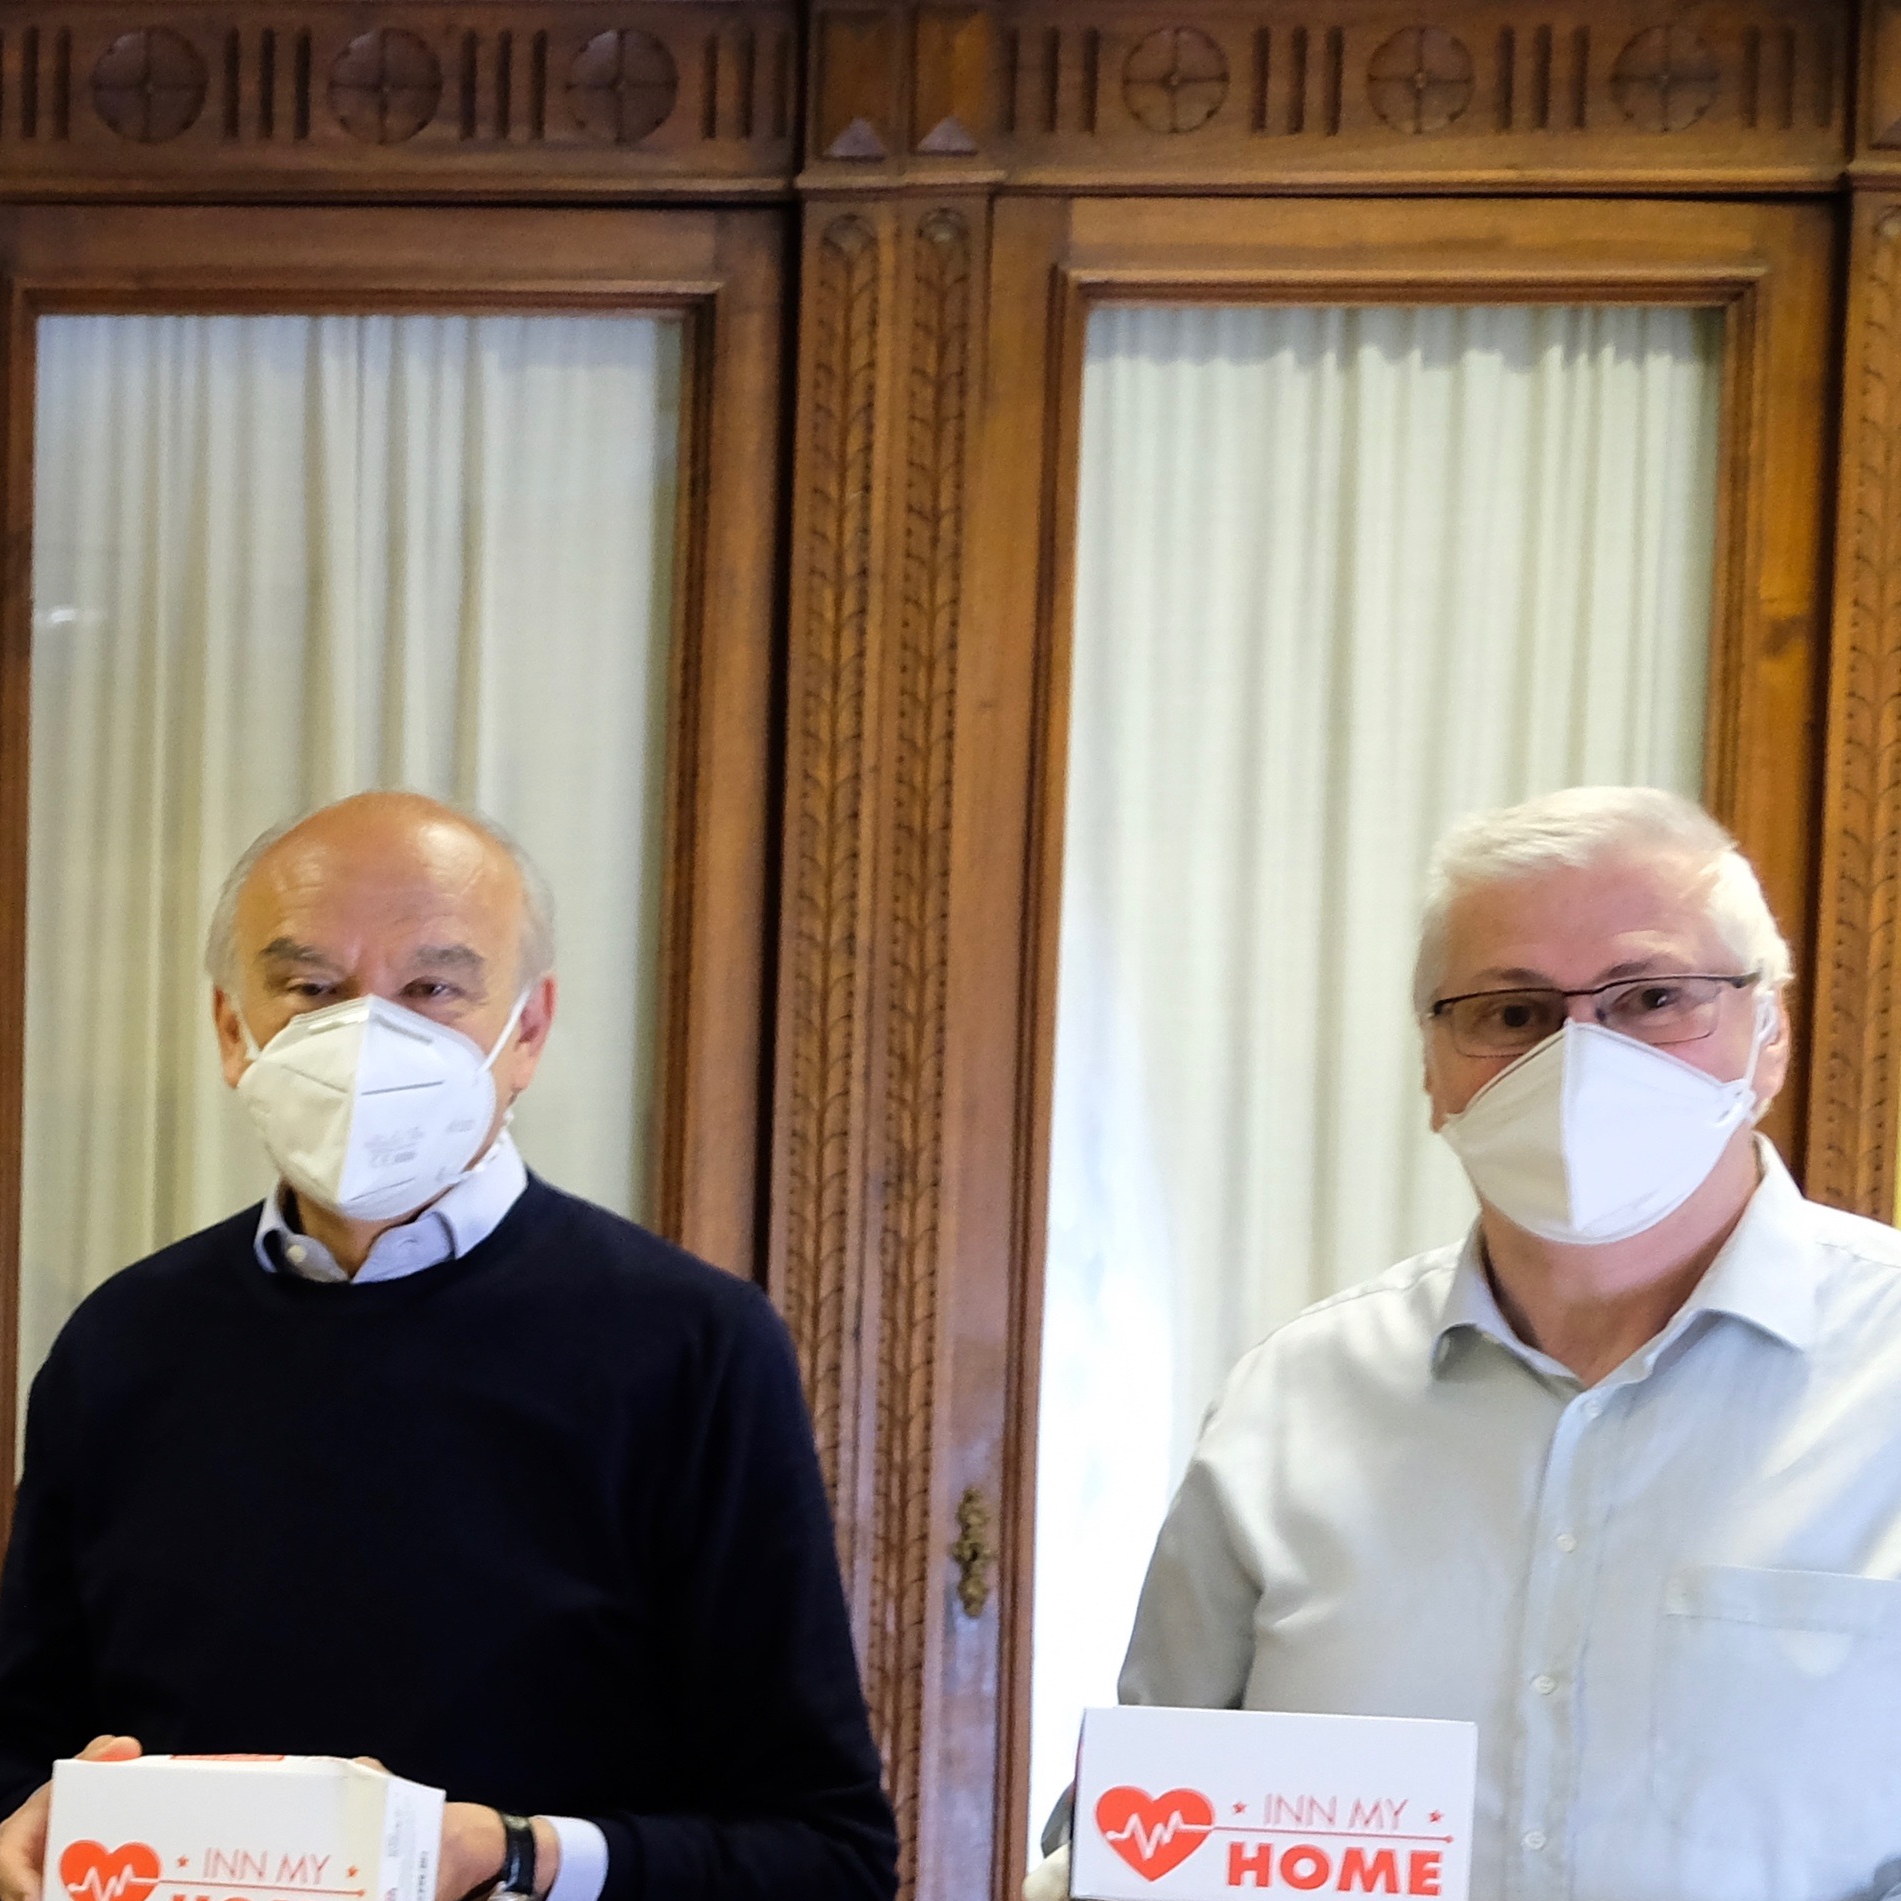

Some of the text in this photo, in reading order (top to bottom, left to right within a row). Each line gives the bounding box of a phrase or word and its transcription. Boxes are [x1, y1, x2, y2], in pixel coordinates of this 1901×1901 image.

[1263, 1793, 1409, 1831] INN MY
[203, 1847, 332, 1886] INN MY
[1227, 1841, 1444, 1897] HOME
